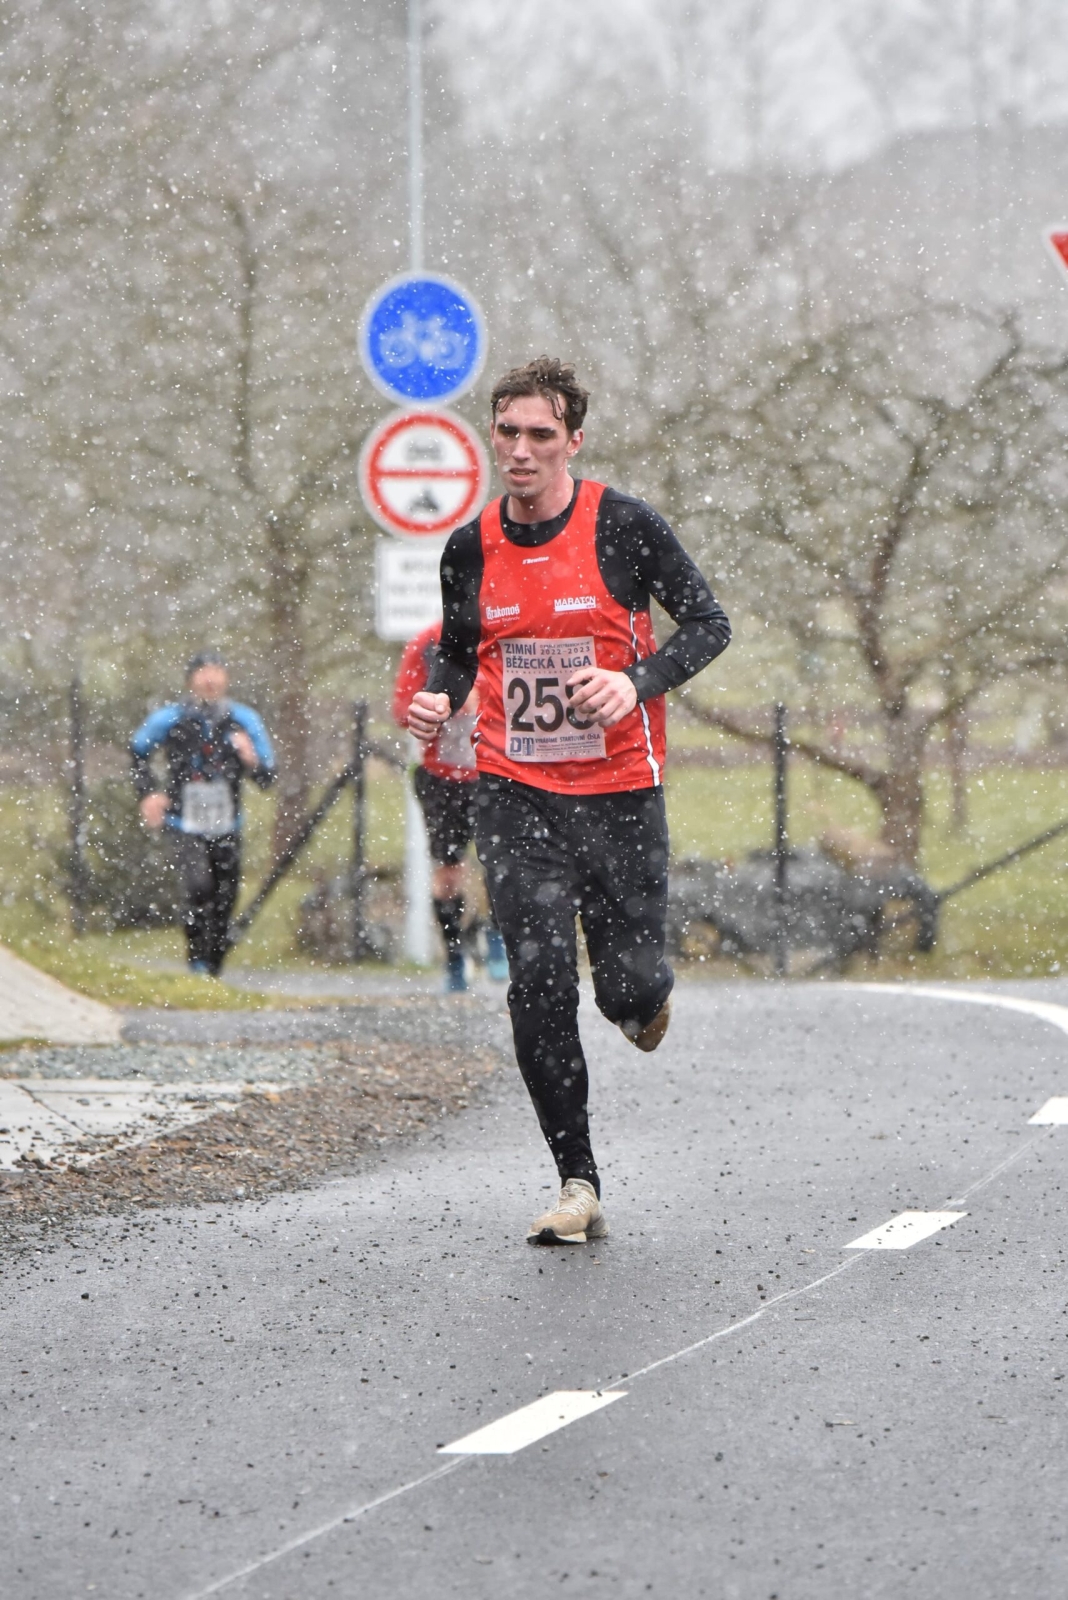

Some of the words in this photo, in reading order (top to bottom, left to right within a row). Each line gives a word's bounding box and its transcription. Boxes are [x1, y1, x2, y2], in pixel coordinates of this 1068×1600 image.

[554, 596, 596, 607] MARATON
[486, 604, 520, 620] Krakonoš
[504, 642, 536, 655] ZIMNÍ
[505, 656, 555, 669] BĚŽECKÁ
[561, 655, 592, 669] LIGA
[560, 734, 586, 742] STARTOVNÍ
